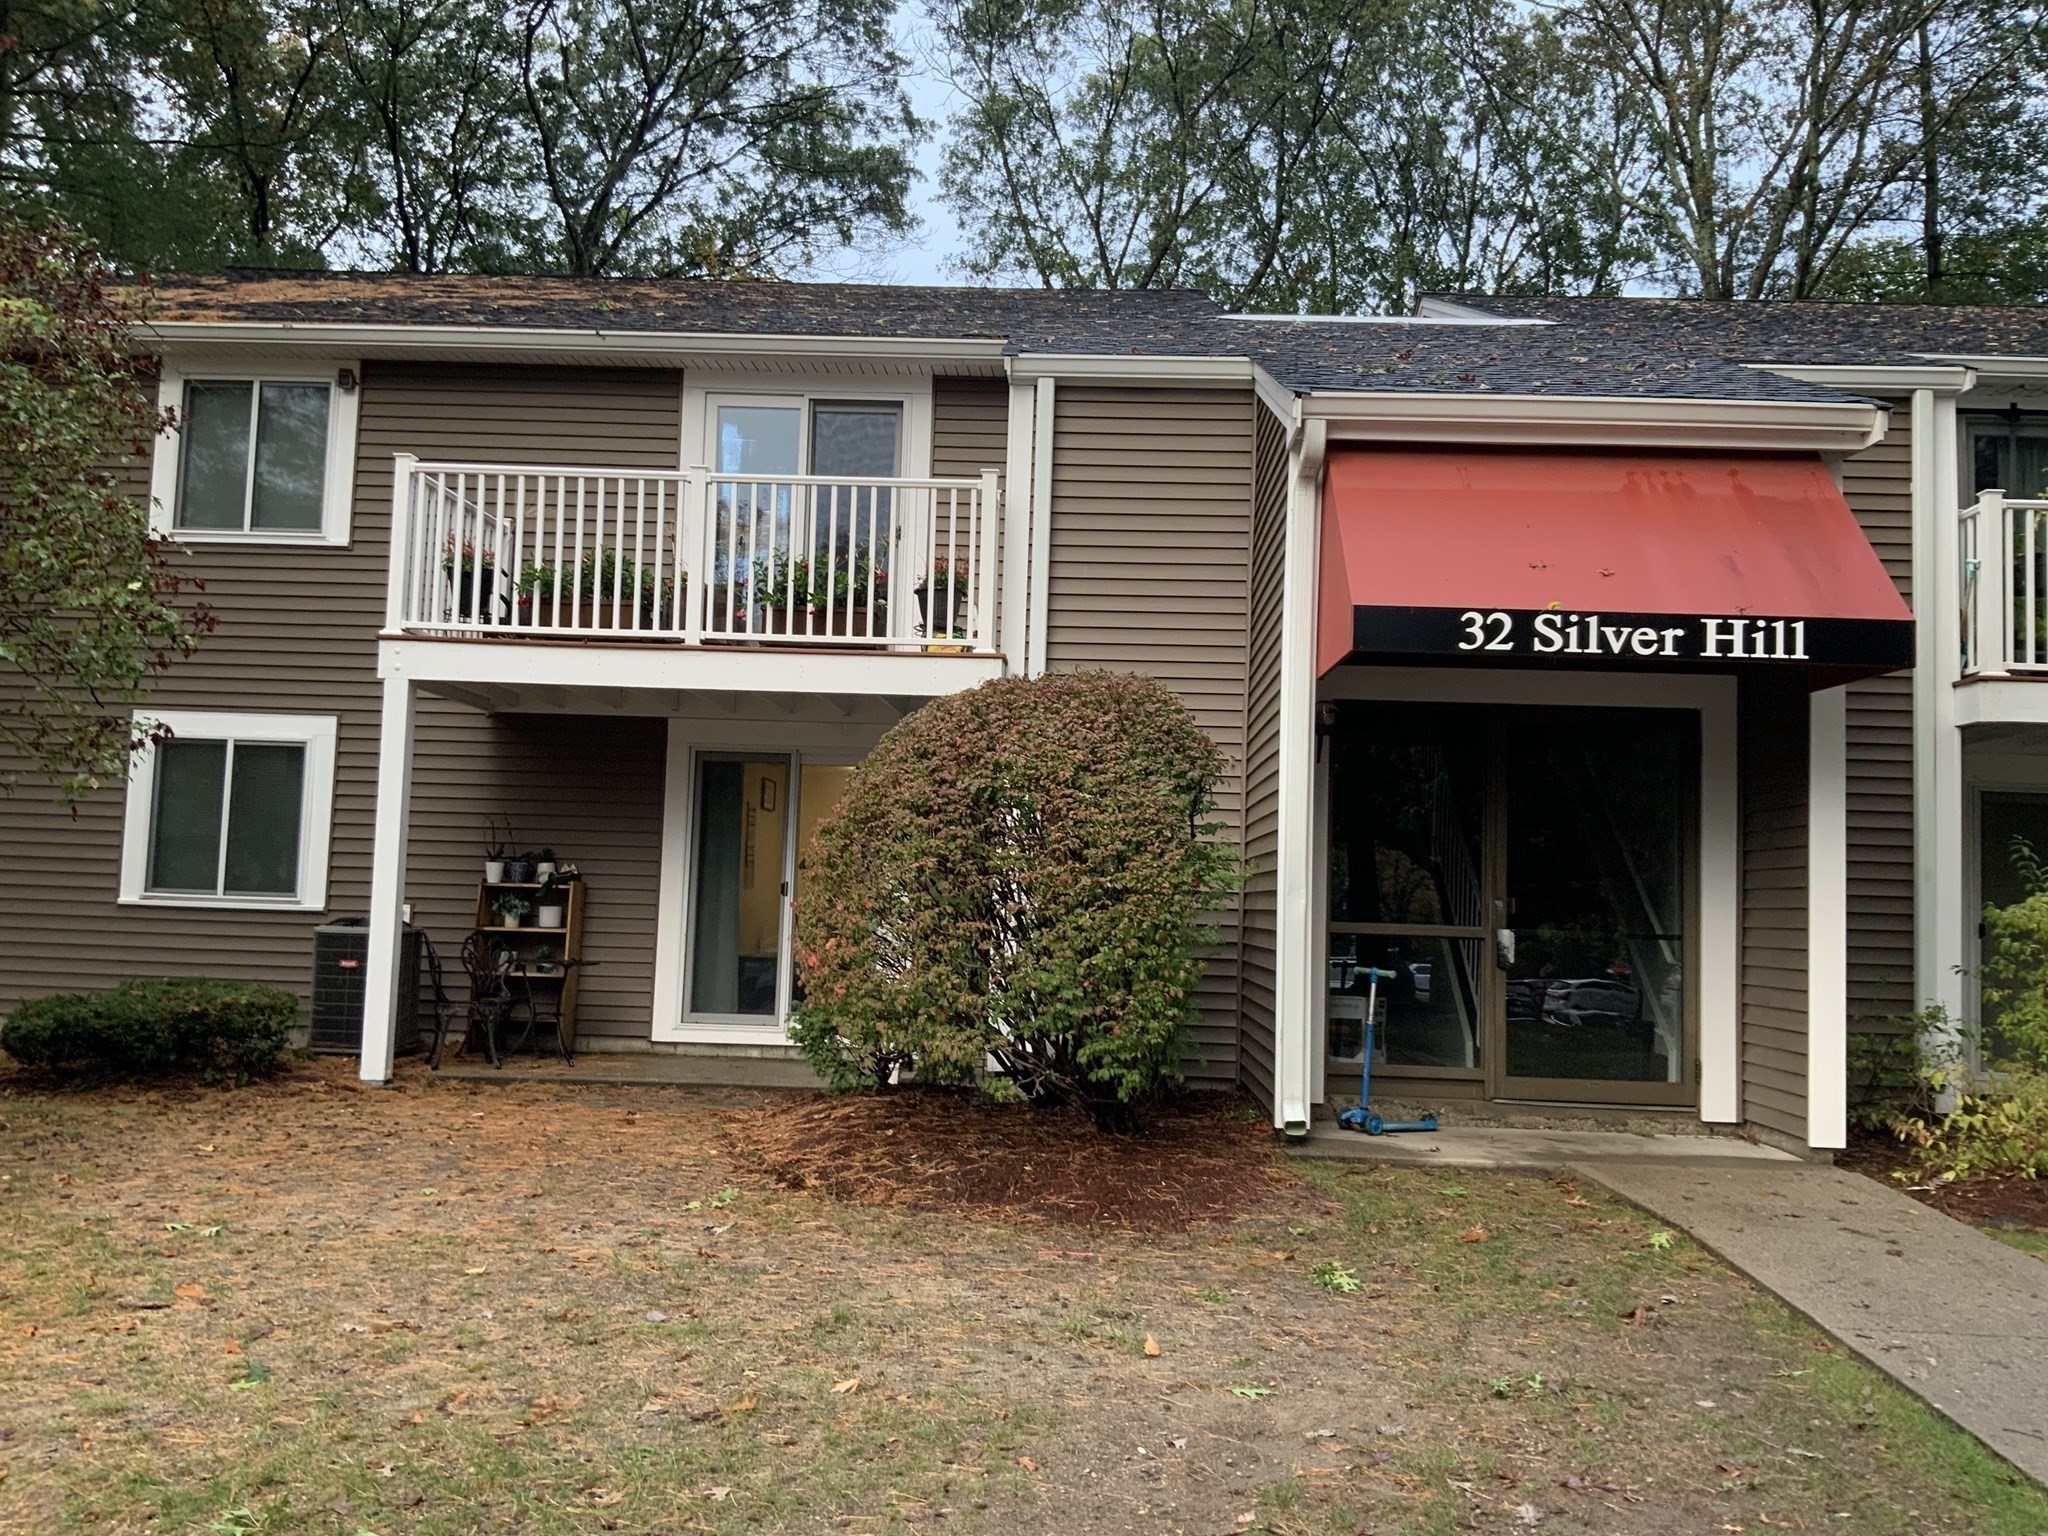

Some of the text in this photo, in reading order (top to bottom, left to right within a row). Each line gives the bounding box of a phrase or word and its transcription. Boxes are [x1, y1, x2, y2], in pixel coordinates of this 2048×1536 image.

[1458, 611, 1810, 660] 32 Silver Hill
